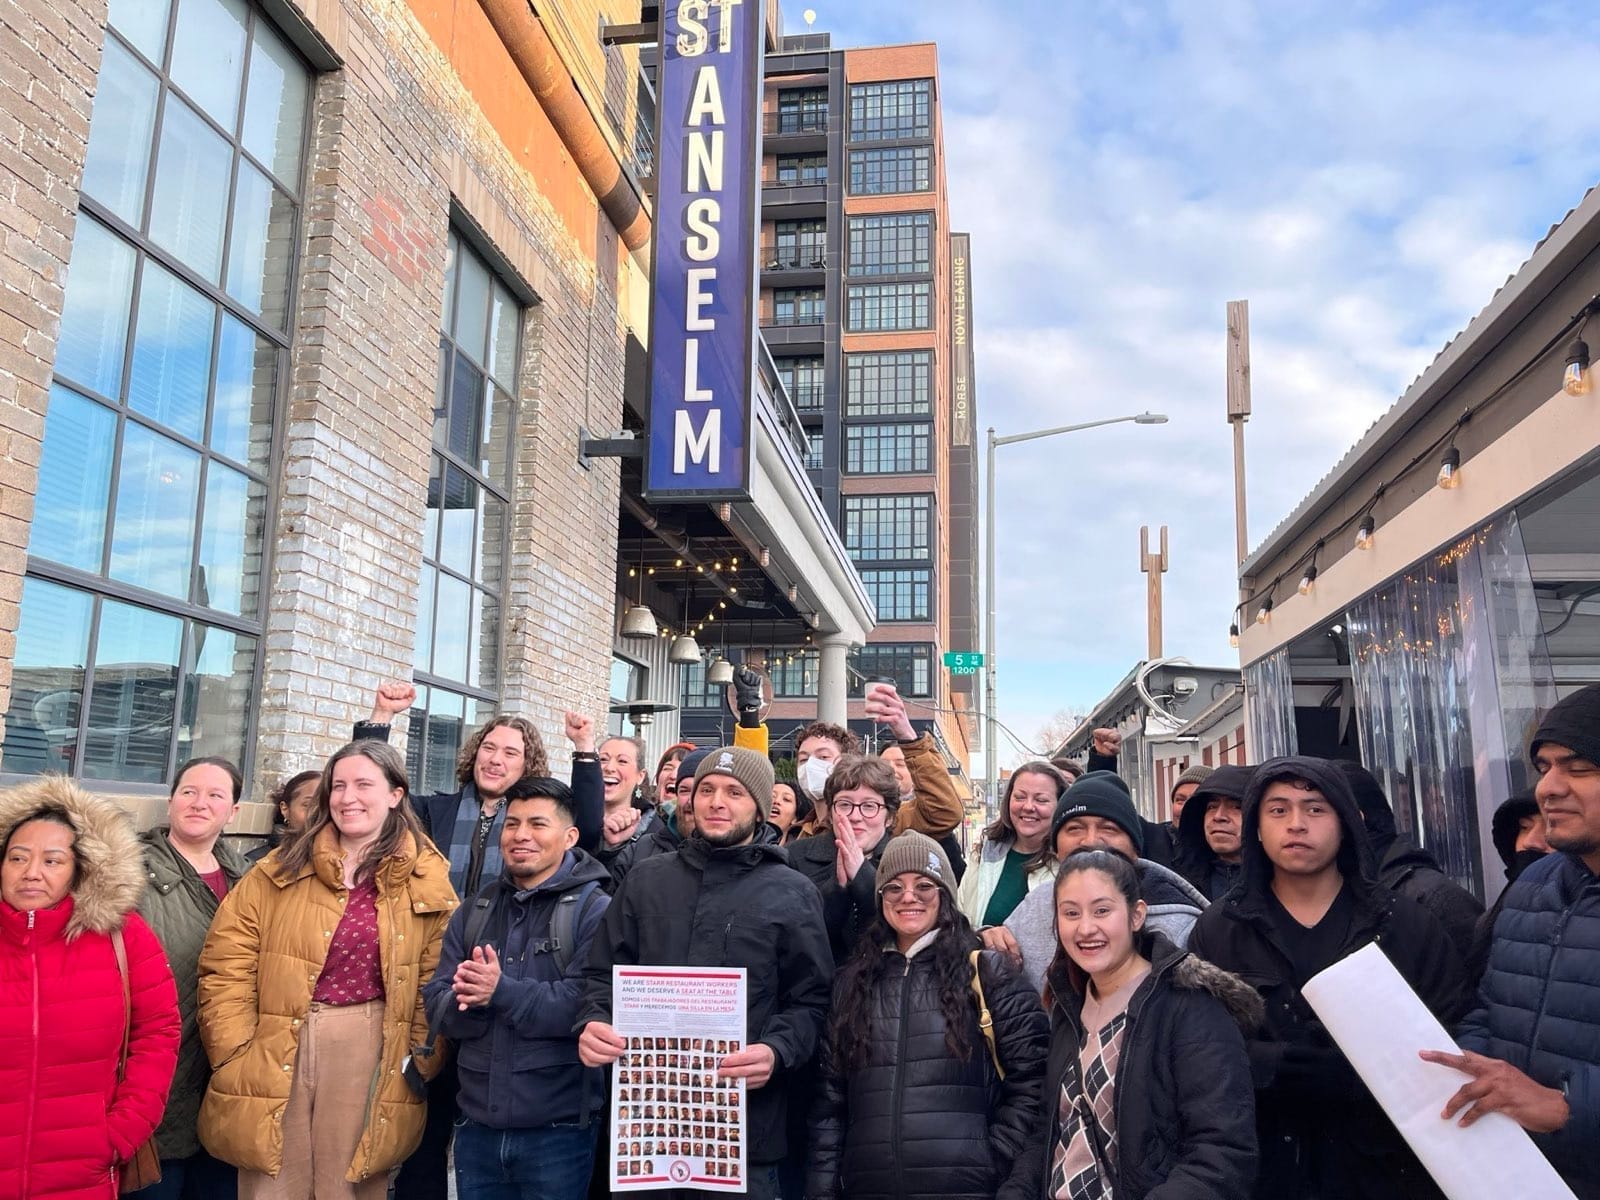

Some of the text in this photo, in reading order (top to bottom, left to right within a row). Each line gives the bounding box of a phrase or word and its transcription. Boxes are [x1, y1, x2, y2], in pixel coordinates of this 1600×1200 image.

[676, 0, 743, 57] ST
[673, 66, 726, 474] ANSELM
[955, 257, 966, 345] NOW LEASING
[955, 376, 966, 419] MORSE
[955, 654, 964, 666] 5
